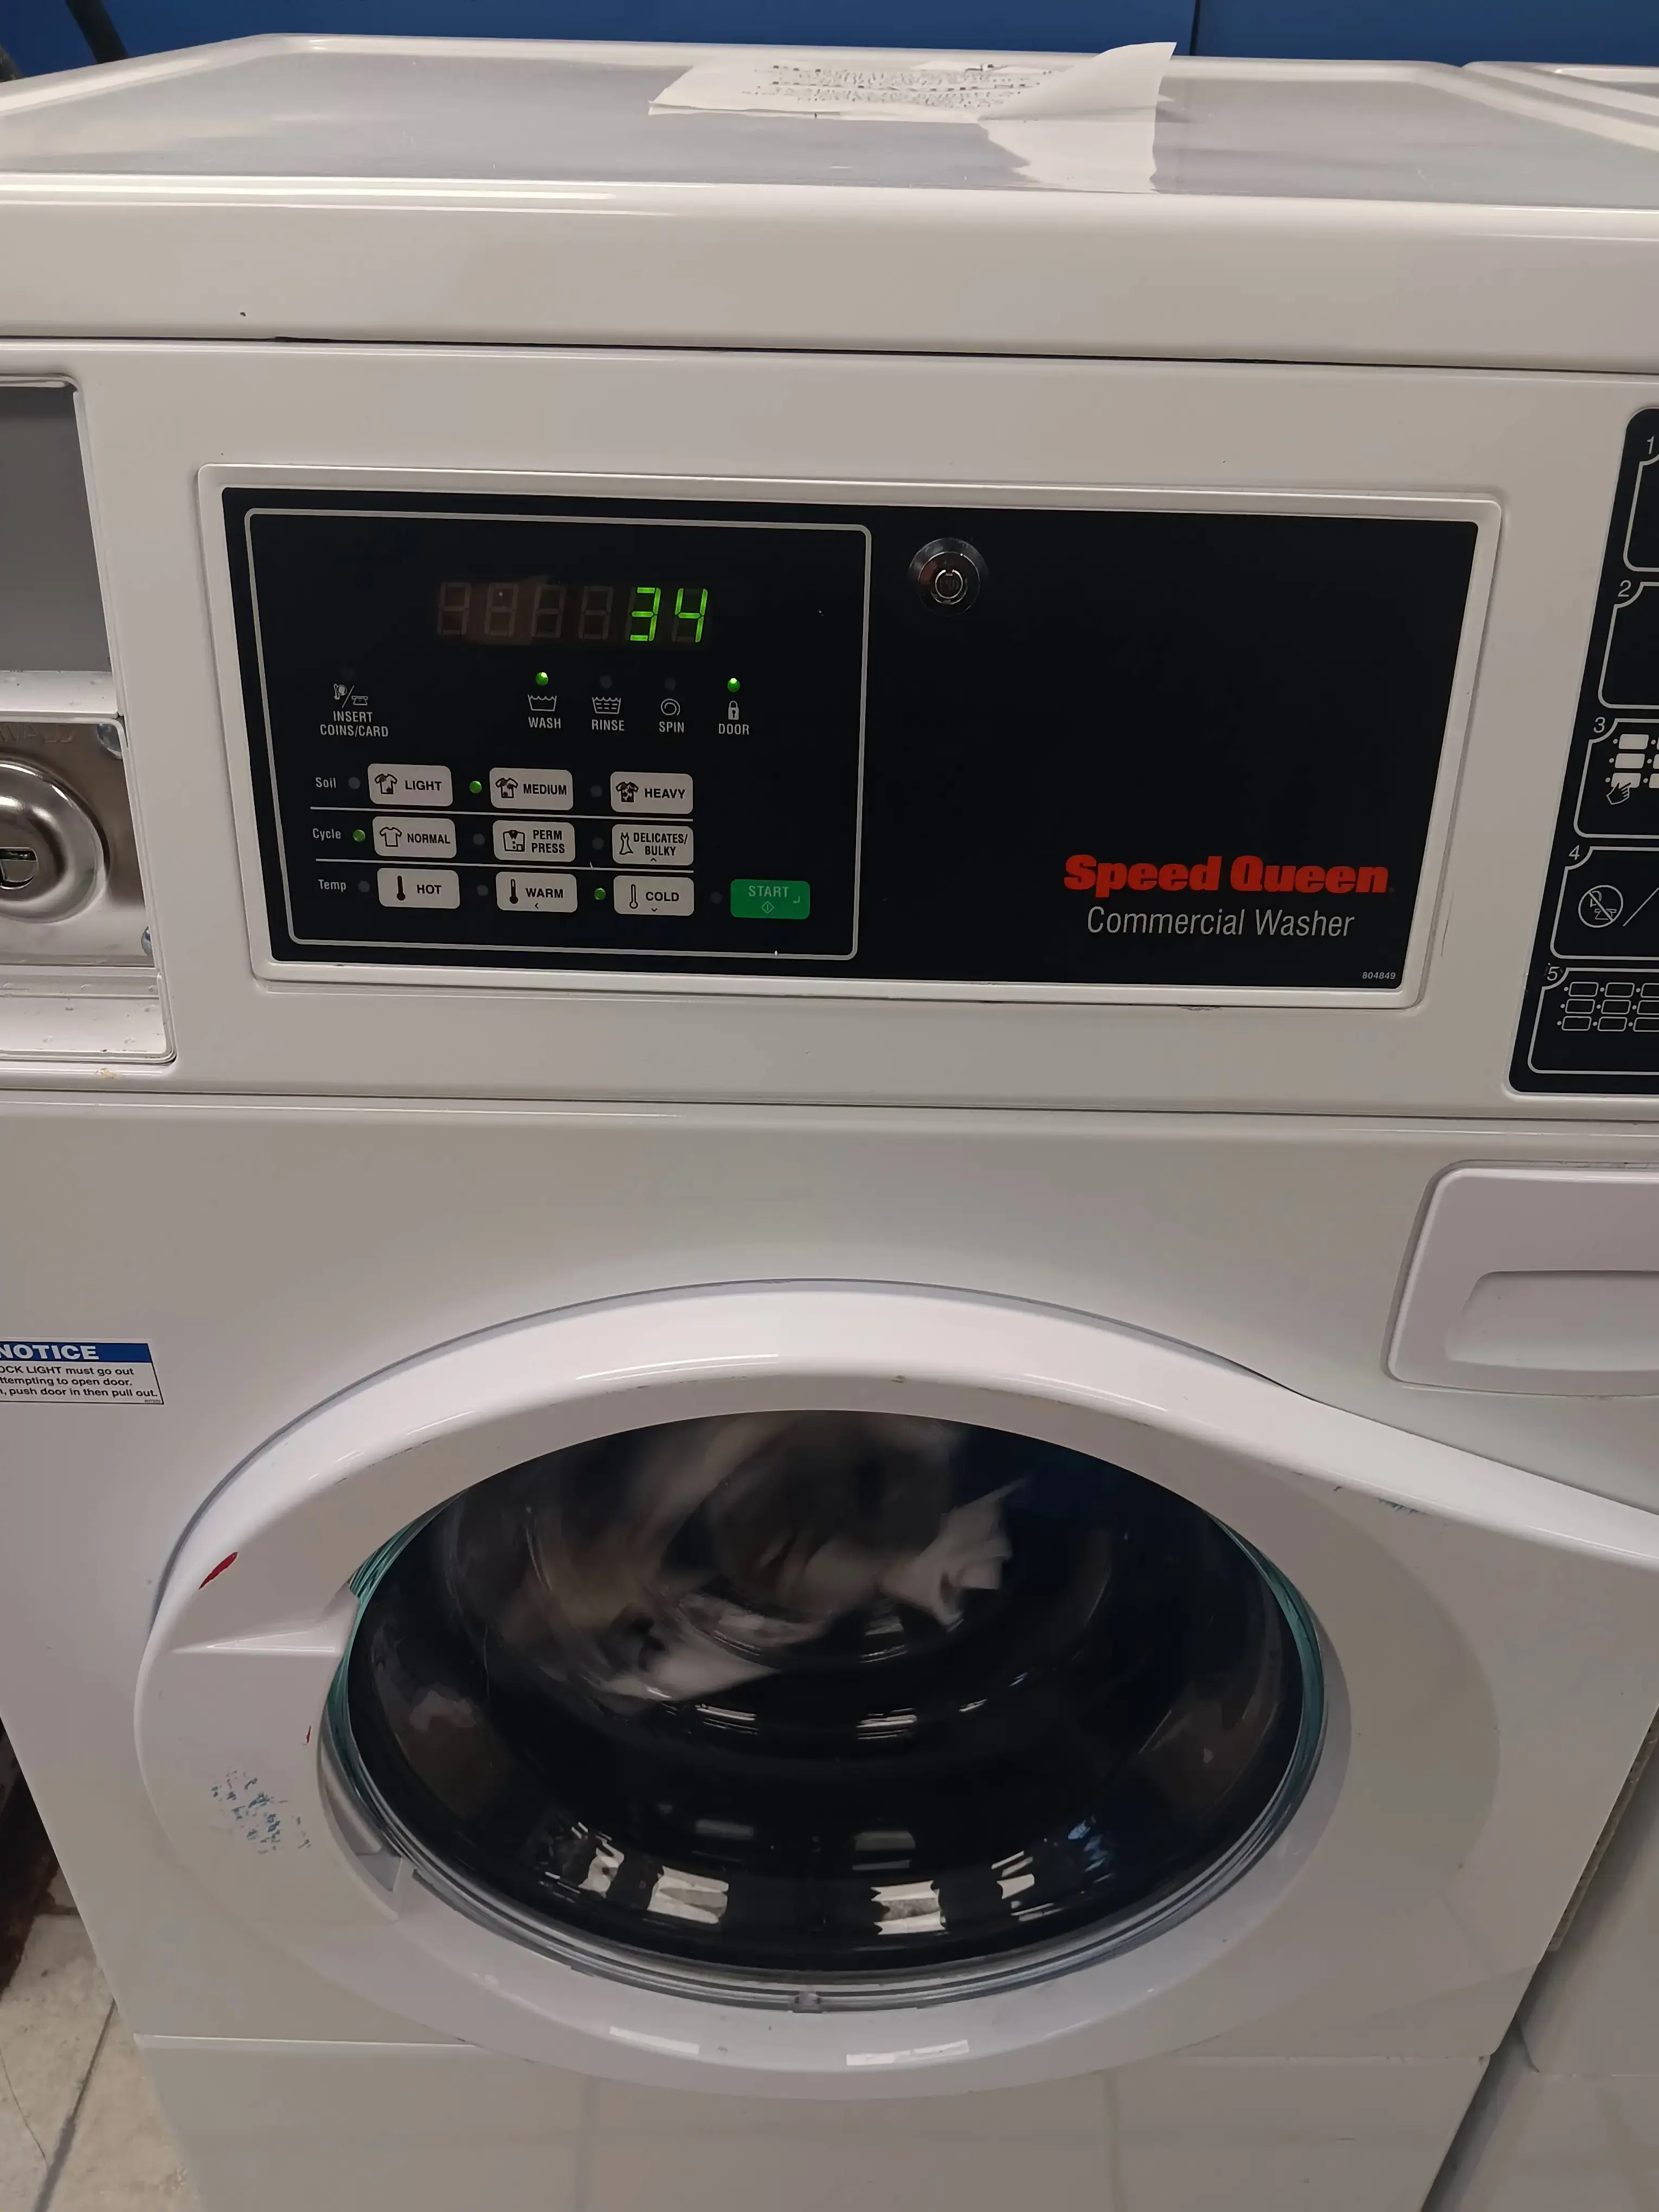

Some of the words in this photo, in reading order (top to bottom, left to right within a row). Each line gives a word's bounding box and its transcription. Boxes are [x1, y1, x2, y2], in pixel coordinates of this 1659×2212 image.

[1646, 434, 1655, 455] 1
[1617, 579, 1632, 598] 2
[629, 587, 709, 643] 34
[333, 710, 373, 723] INSERT
[528, 716, 562, 729] WASH
[319, 723, 389, 738] COINS/CARD
[591, 719, 625, 732] RINSE
[658, 721, 685, 734] SPIN
[718, 723, 750, 736] DOOR
[1593, 716, 1606, 734] 3
[315, 776, 337, 789] Soil
[404, 780, 442, 792] LIGHT
[523, 783, 568, 796] MEDIUM
[644, 788, 686, 800] HEAVY
[312, 828, 342, 841] Cycle
[407, 833, 451, 845] NORMAL
[532, 829, 563, 840] PERM
[633, 832, 689, 845] DELICATES/
[531, 843, 565, 854] PRESS
[645, 845, 677, 857] BULKY
[1568, 844, 1581, 861] 4
[1064, 854, 1223, 898] Speed
[1230, 854, 1389, 894] Queen
[318, 879, 347, 893] Temp
[416, 884, 442, 895] HOT
[748, 885, 790, 898] START
[525, 887, 564, 899] WARM
[645, 891, 680, 902] COLD
[1086, 905, 1245, 936] Commercial
[1255, 909, 1355, 937] Washer
[1361, 971, 1397, 981] 804849
[1547, 966, 1560, 982] 5
[0, 1344, 99, 1360] NOTICE
[26, 1366, 62, 1374] LIGHT
[97, 1368, 112, 1377] go
[9, 1387, 37, 1396] push
[112, 1389, 133, 1398] pull
